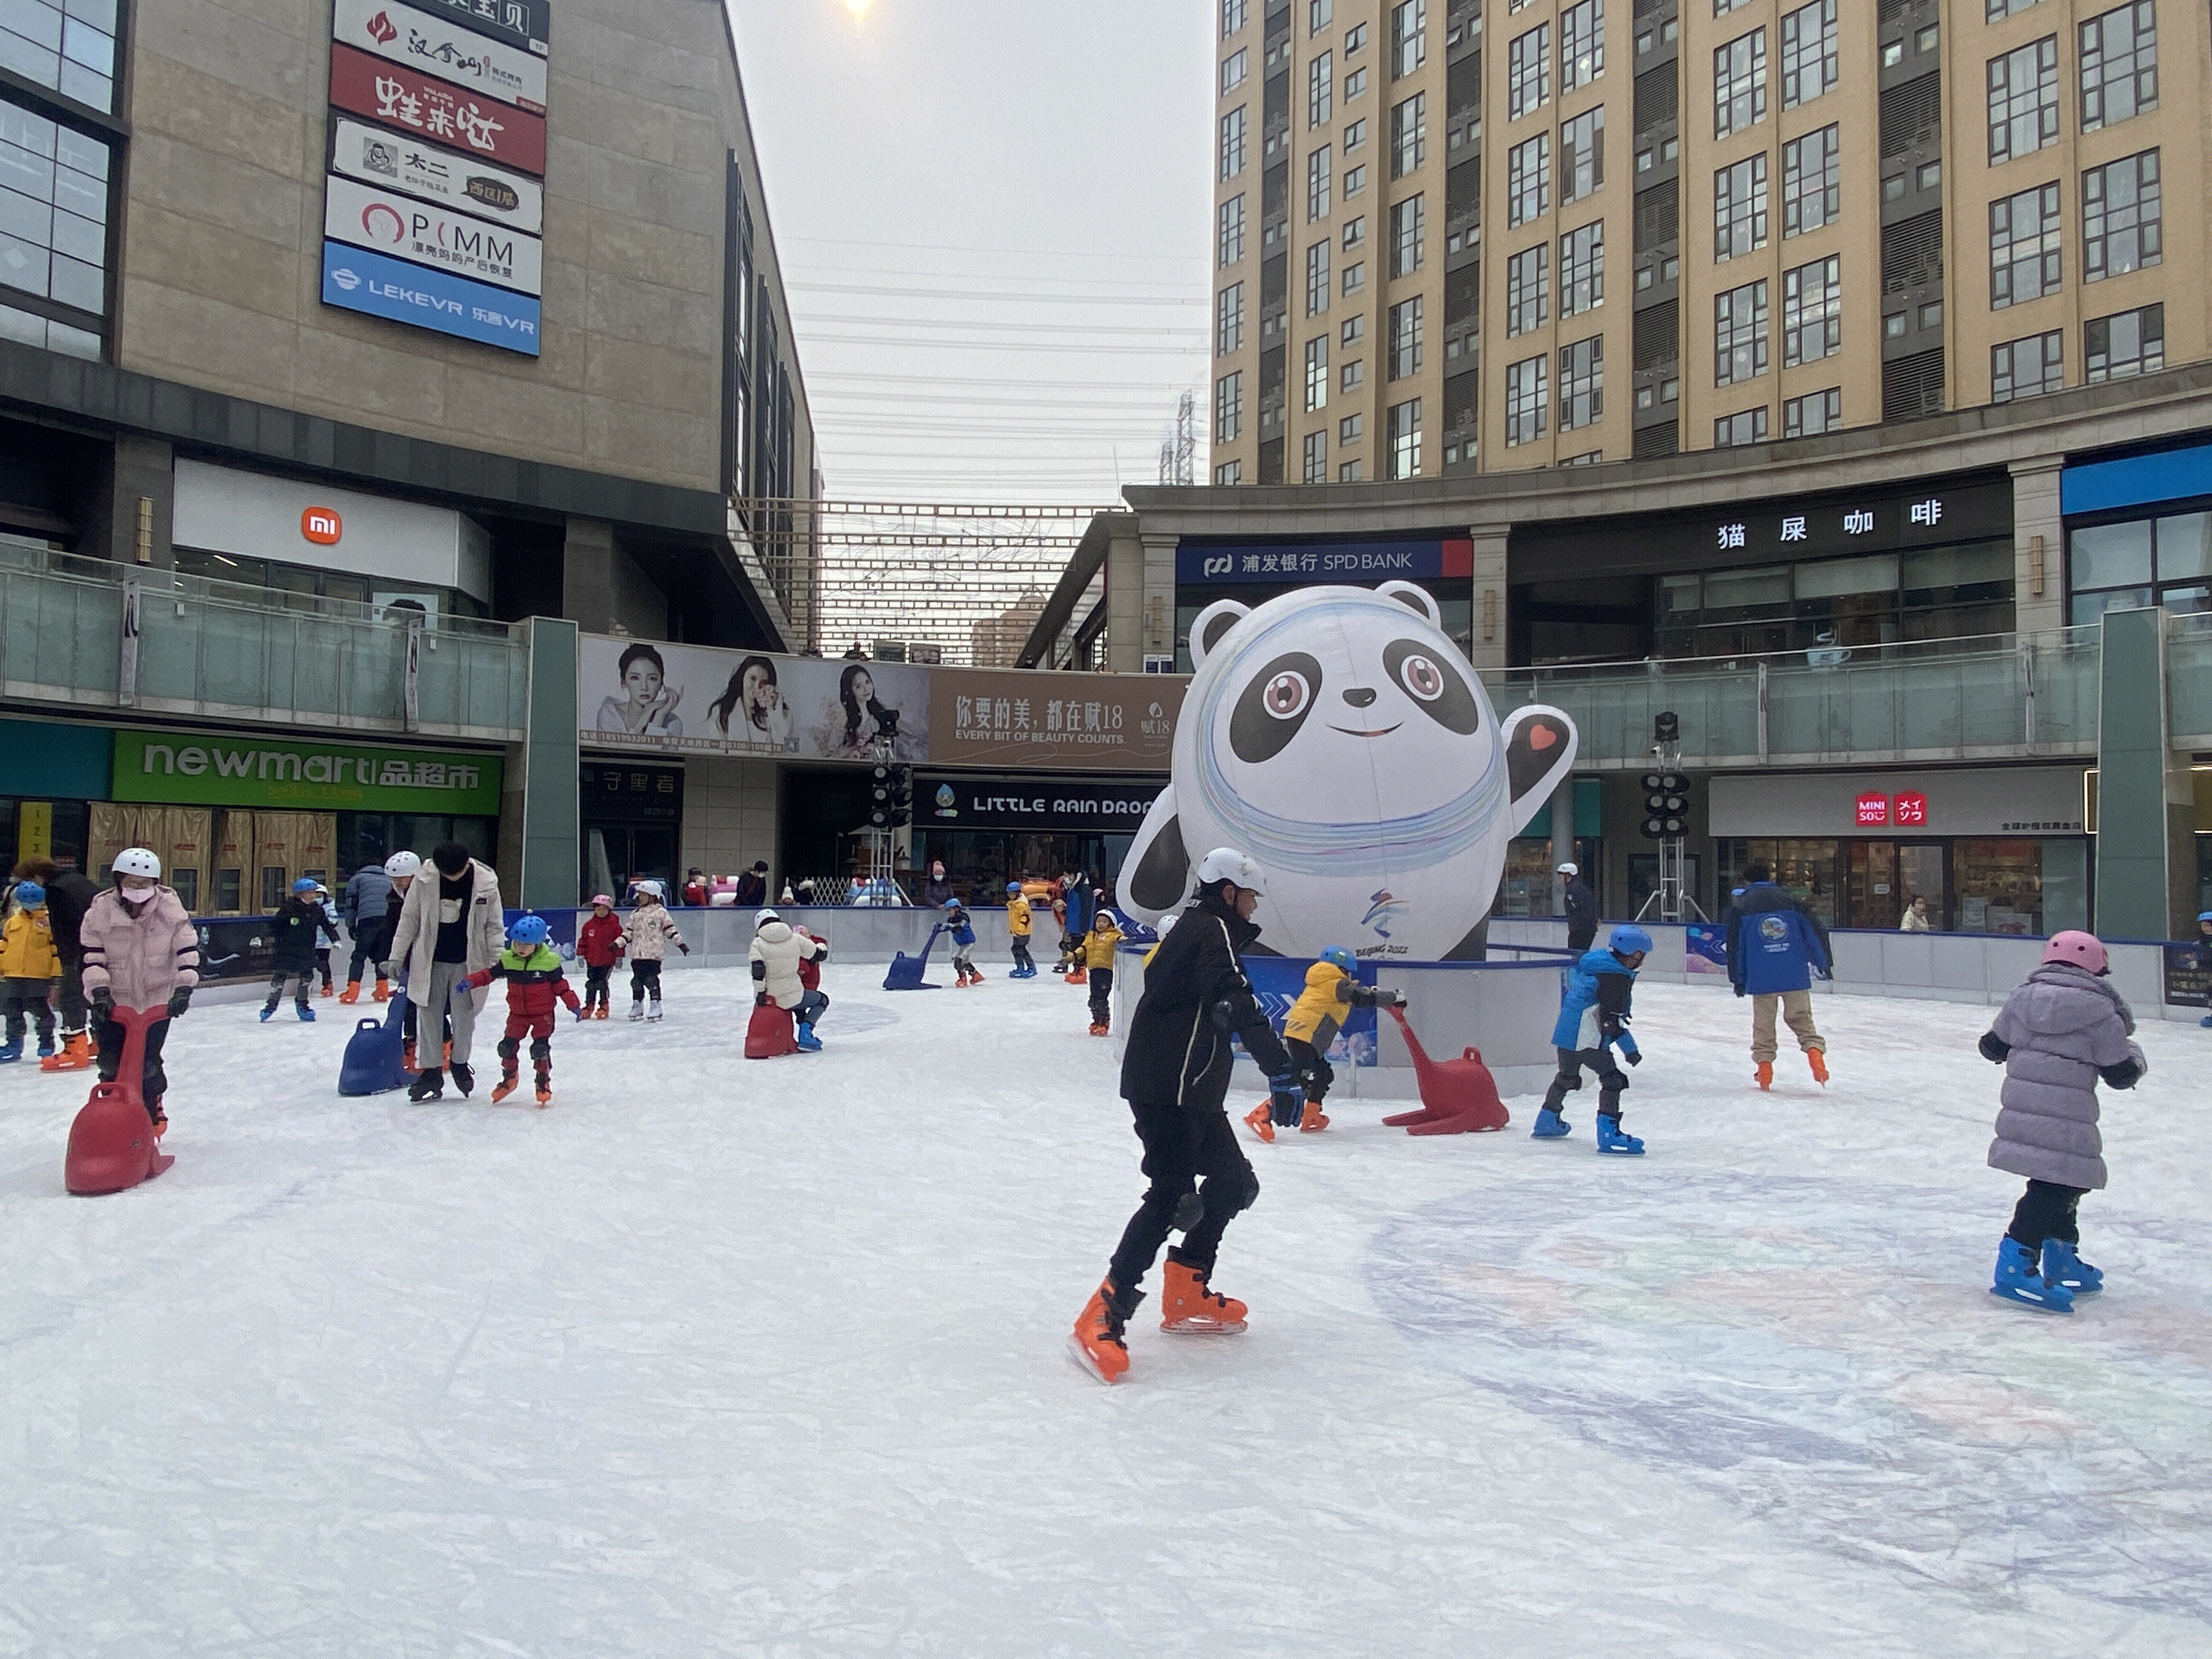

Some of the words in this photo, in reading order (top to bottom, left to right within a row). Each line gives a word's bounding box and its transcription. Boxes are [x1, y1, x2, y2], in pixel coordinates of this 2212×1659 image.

[405, 153, 449, 178] 太二
[369, 280, 462, 316] LEKEVR
[1242, 553, 1318, 572] 浦发银行
[1324, 554, 1358, 570] SPD
[1362, 552, 1413, 569] BANK
[956, 729, 991, 741] EVERY
[994, 731, 1011, 741] BIT
[1014, 731, 1029, 741] OF
[1031, 732, 1074, 743] BEAUTY
[1077, 733, 1126, 744] COUNTS.
[144, 743, 369, 785] newmart
[973, 797, 1045, 812] LITTLE
[1053, 799, 1097, 813] RAIN
[1859, 801, 1885, 810] MINI
[1356, 944, 1386, 957] BEIJING
[1387, 945, 1408, 953] 2022
